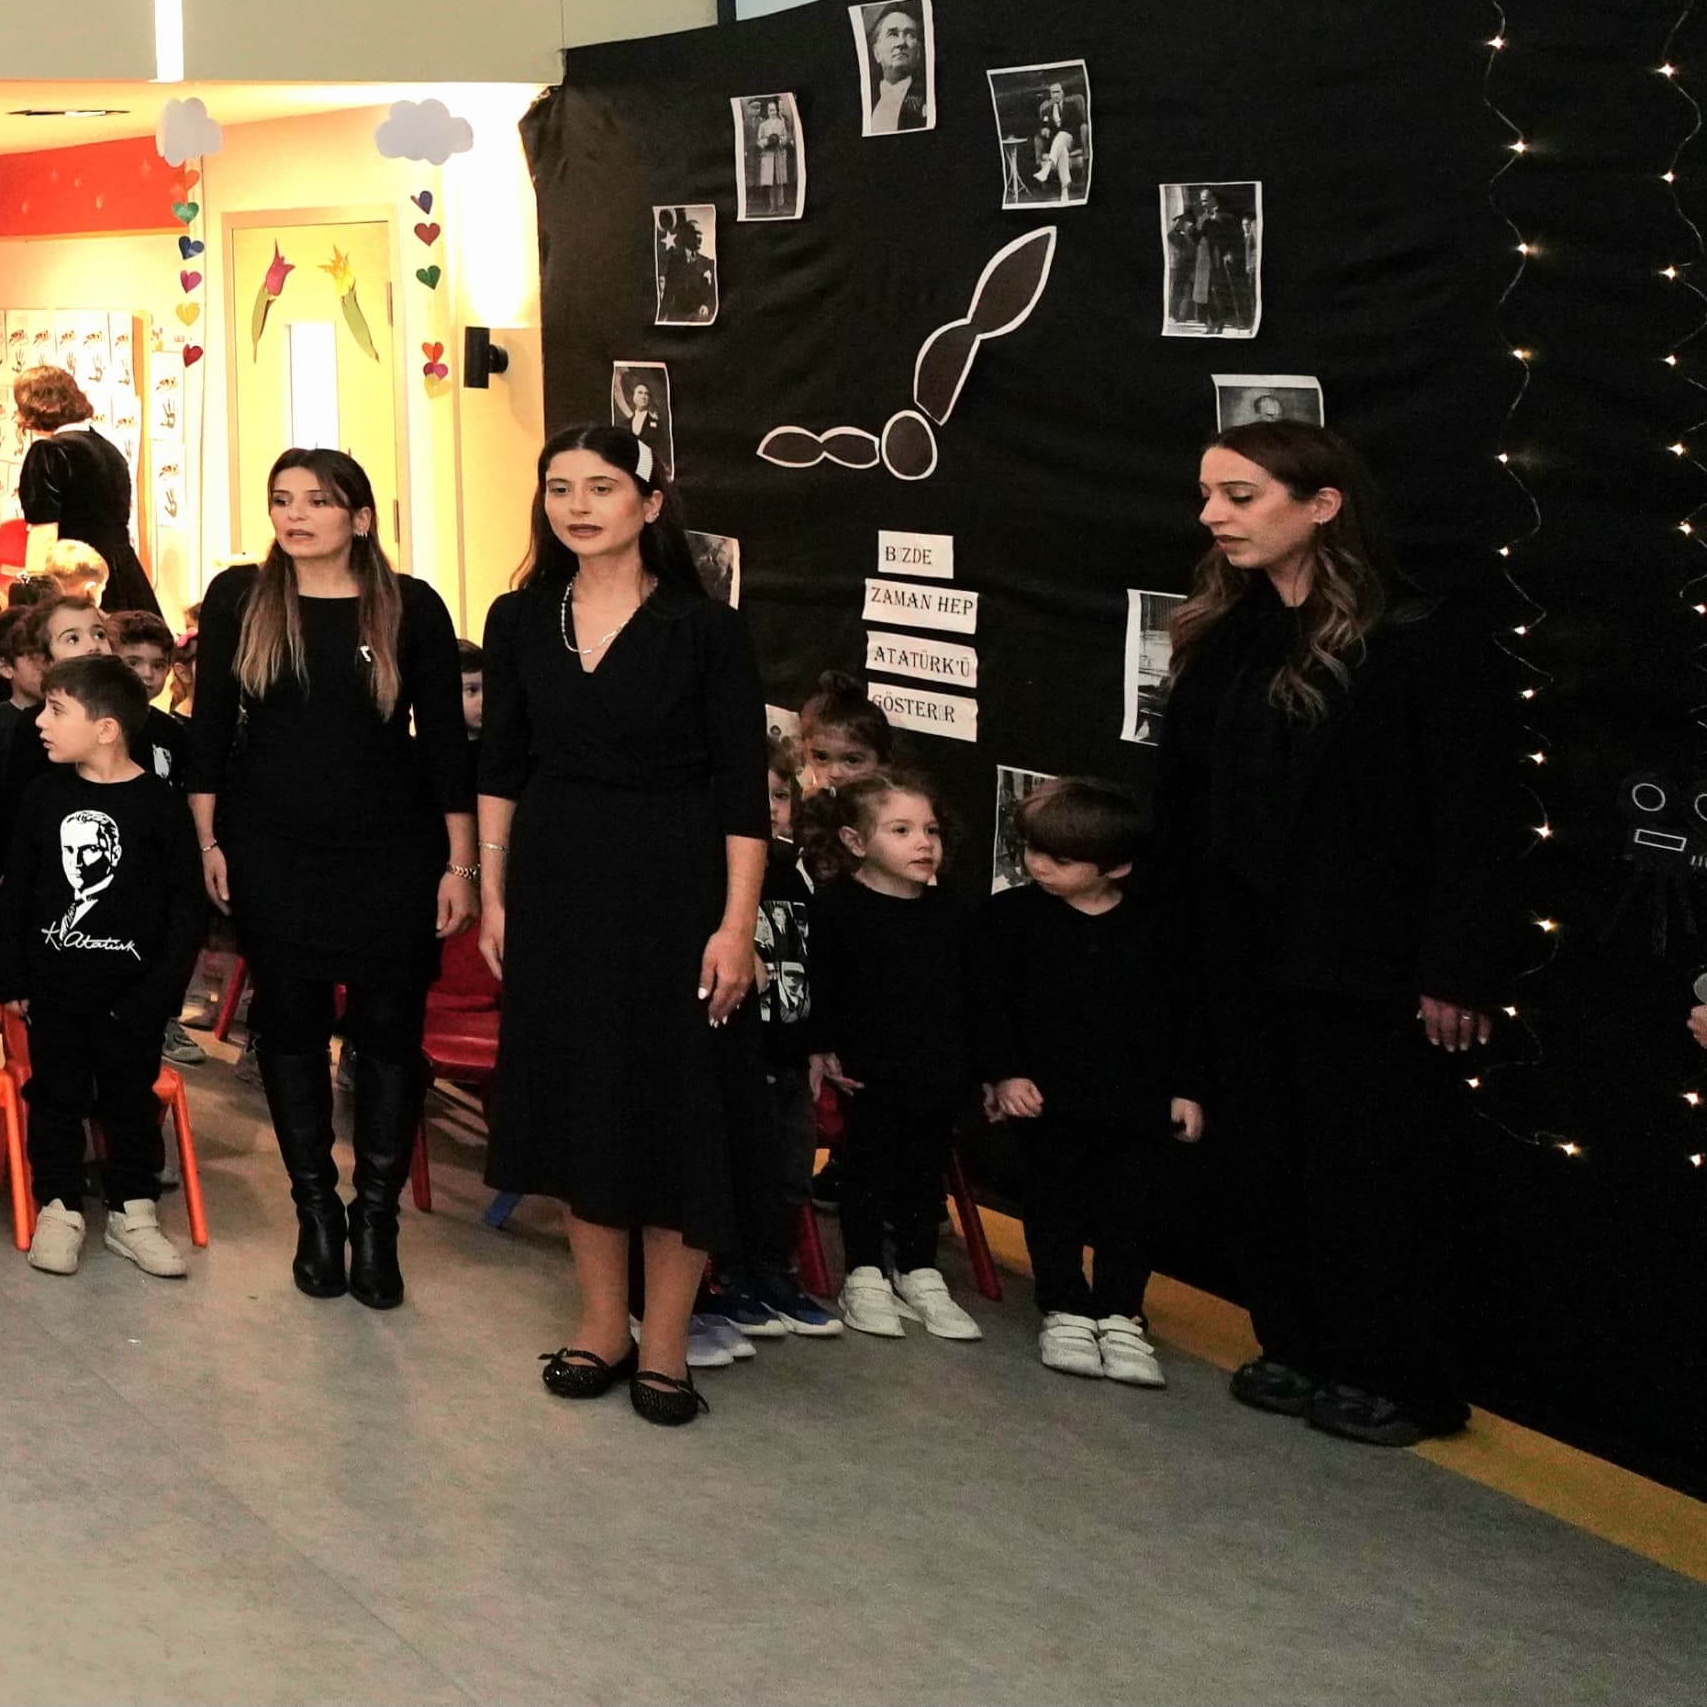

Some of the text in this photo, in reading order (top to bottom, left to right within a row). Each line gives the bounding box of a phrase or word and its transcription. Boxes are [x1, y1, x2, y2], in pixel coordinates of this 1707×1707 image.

[885, 545, 932, 565] BZDE
[871, 586, 973, 615] ZAMAN HEP
[874, 645, 970, 678] ATATÜRK'Ü
[872, 690, 955, 723] GÖSTERR
